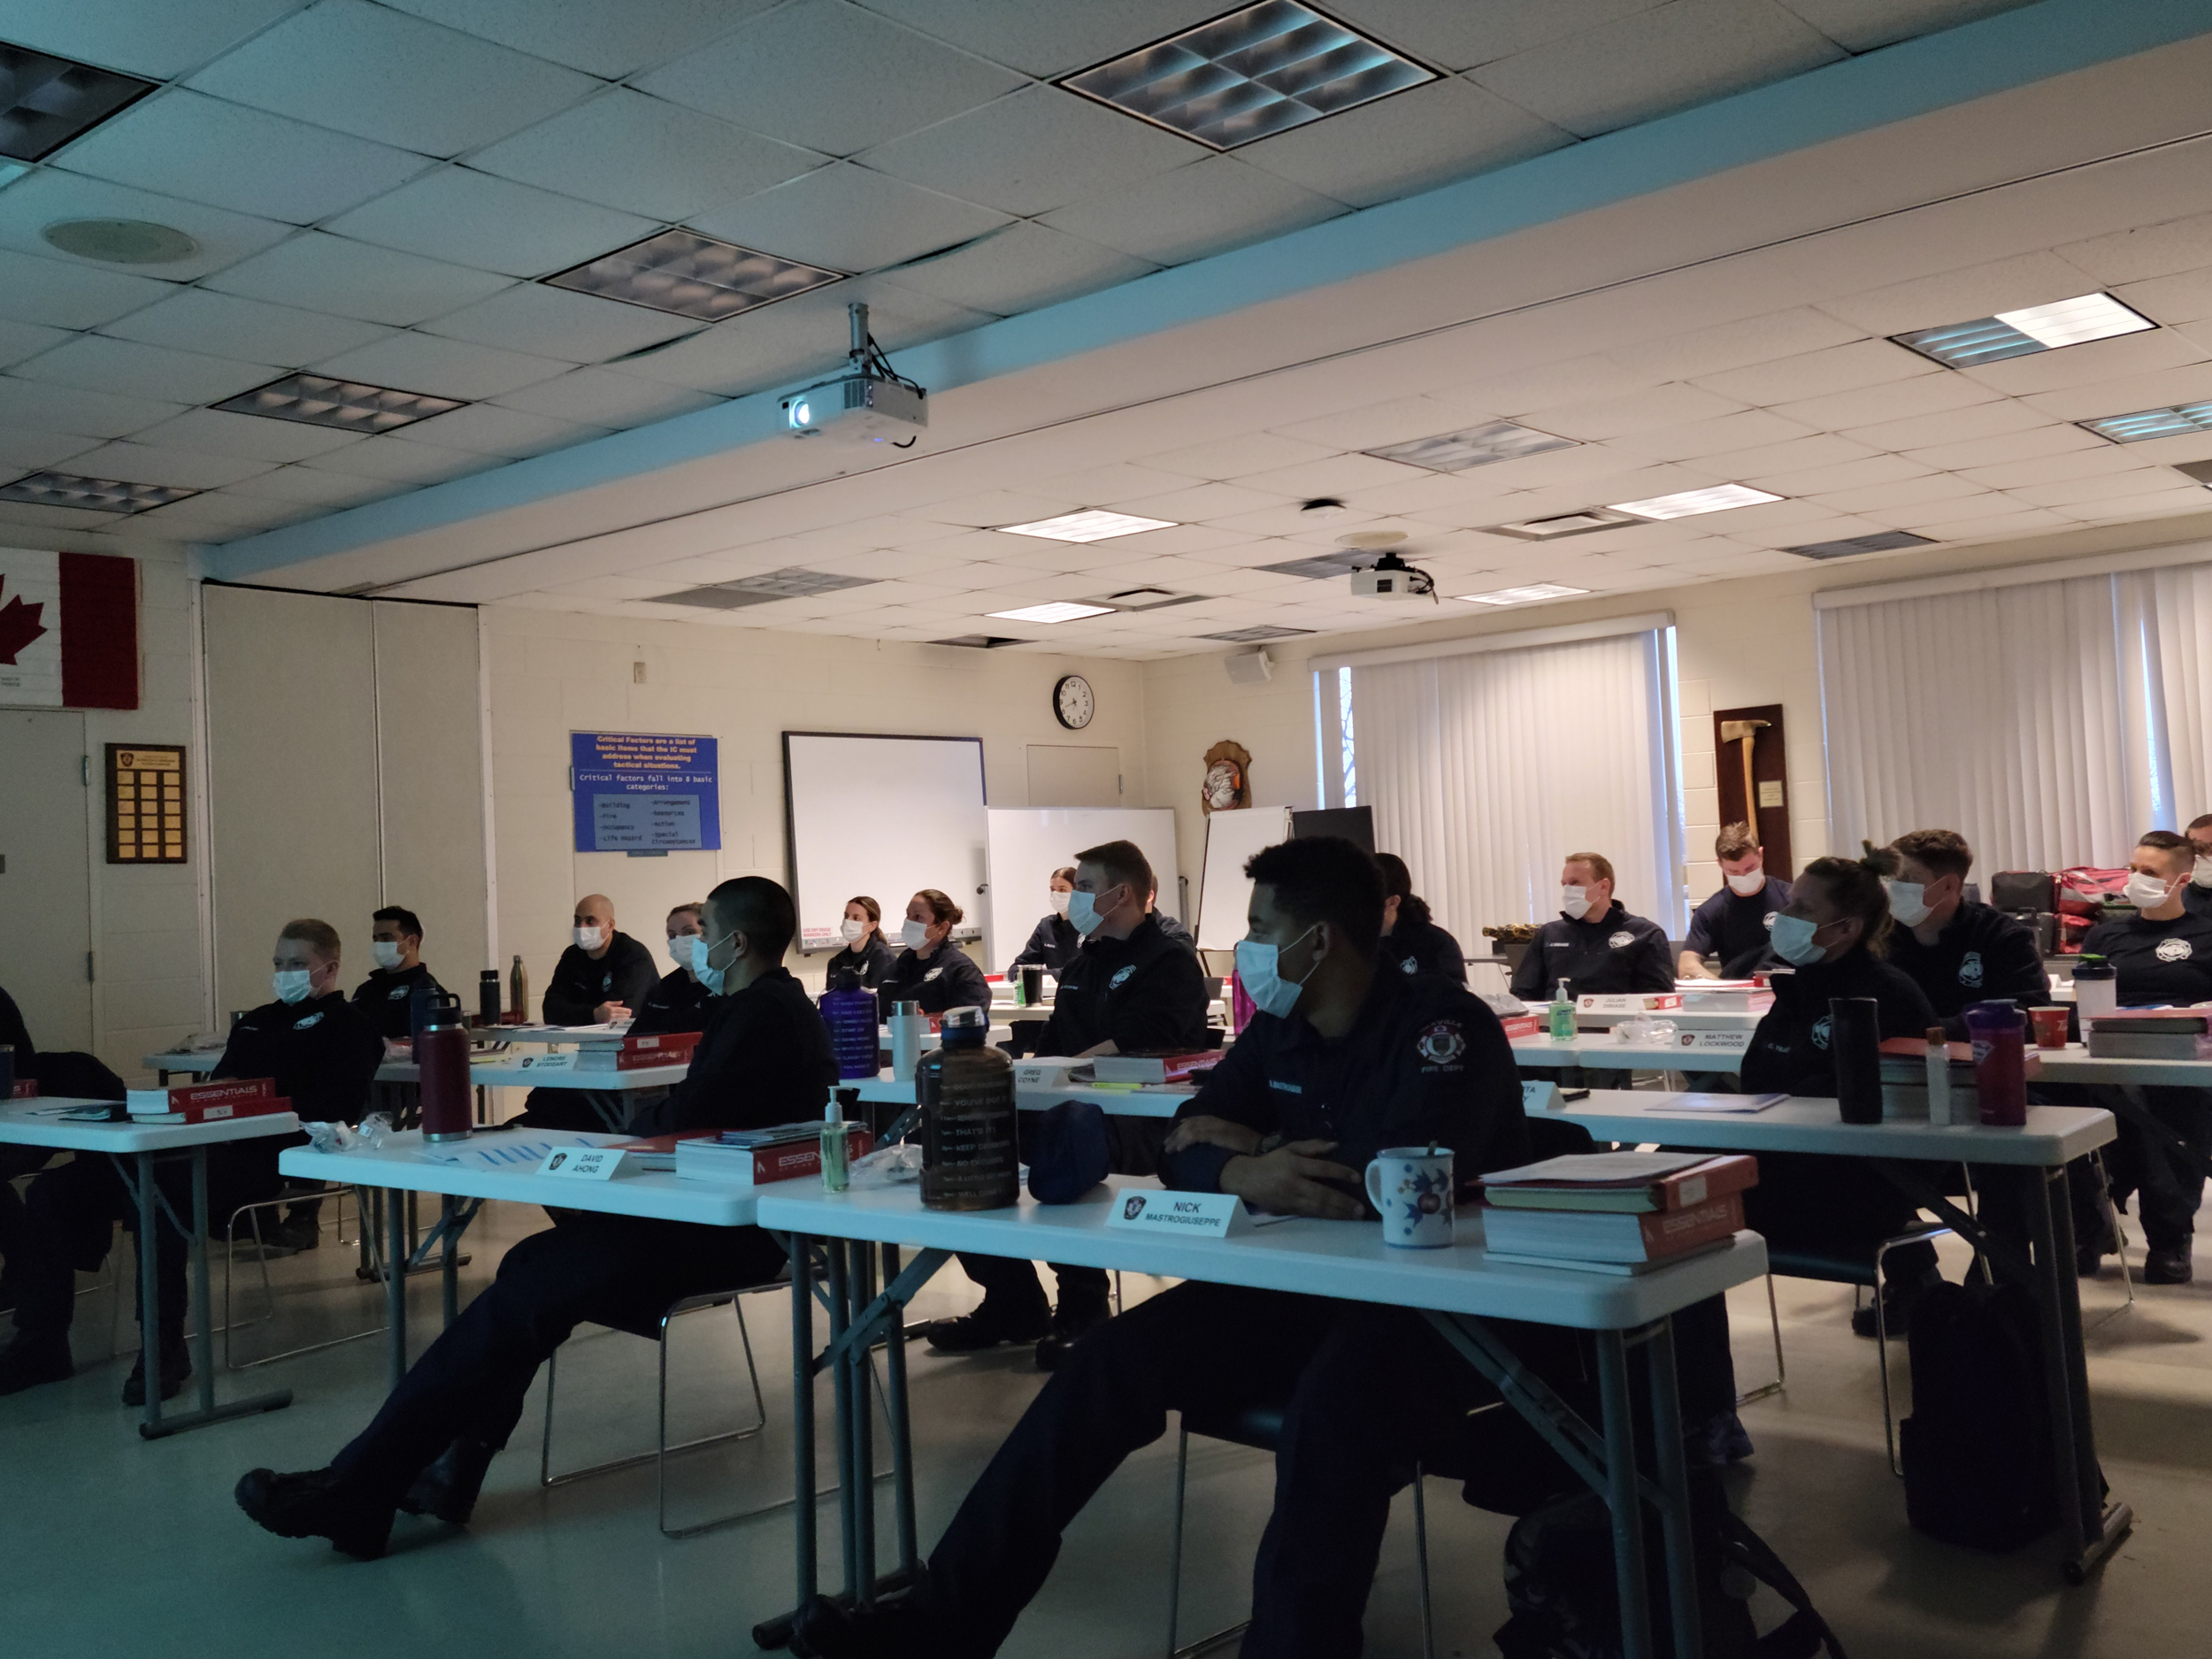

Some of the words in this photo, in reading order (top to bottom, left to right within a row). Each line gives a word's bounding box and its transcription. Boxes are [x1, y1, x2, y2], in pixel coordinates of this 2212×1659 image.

[190, 1086, 257, 1100] ESSENTIALS
[580, 1154, 603, 1163] DAVID
[572, 1164, 599, 1173] AHONG
[1173, 1202, 1202, 1213] NICK
[1145, 1213, 1221, 1226] MASTROGIUSEPPE
